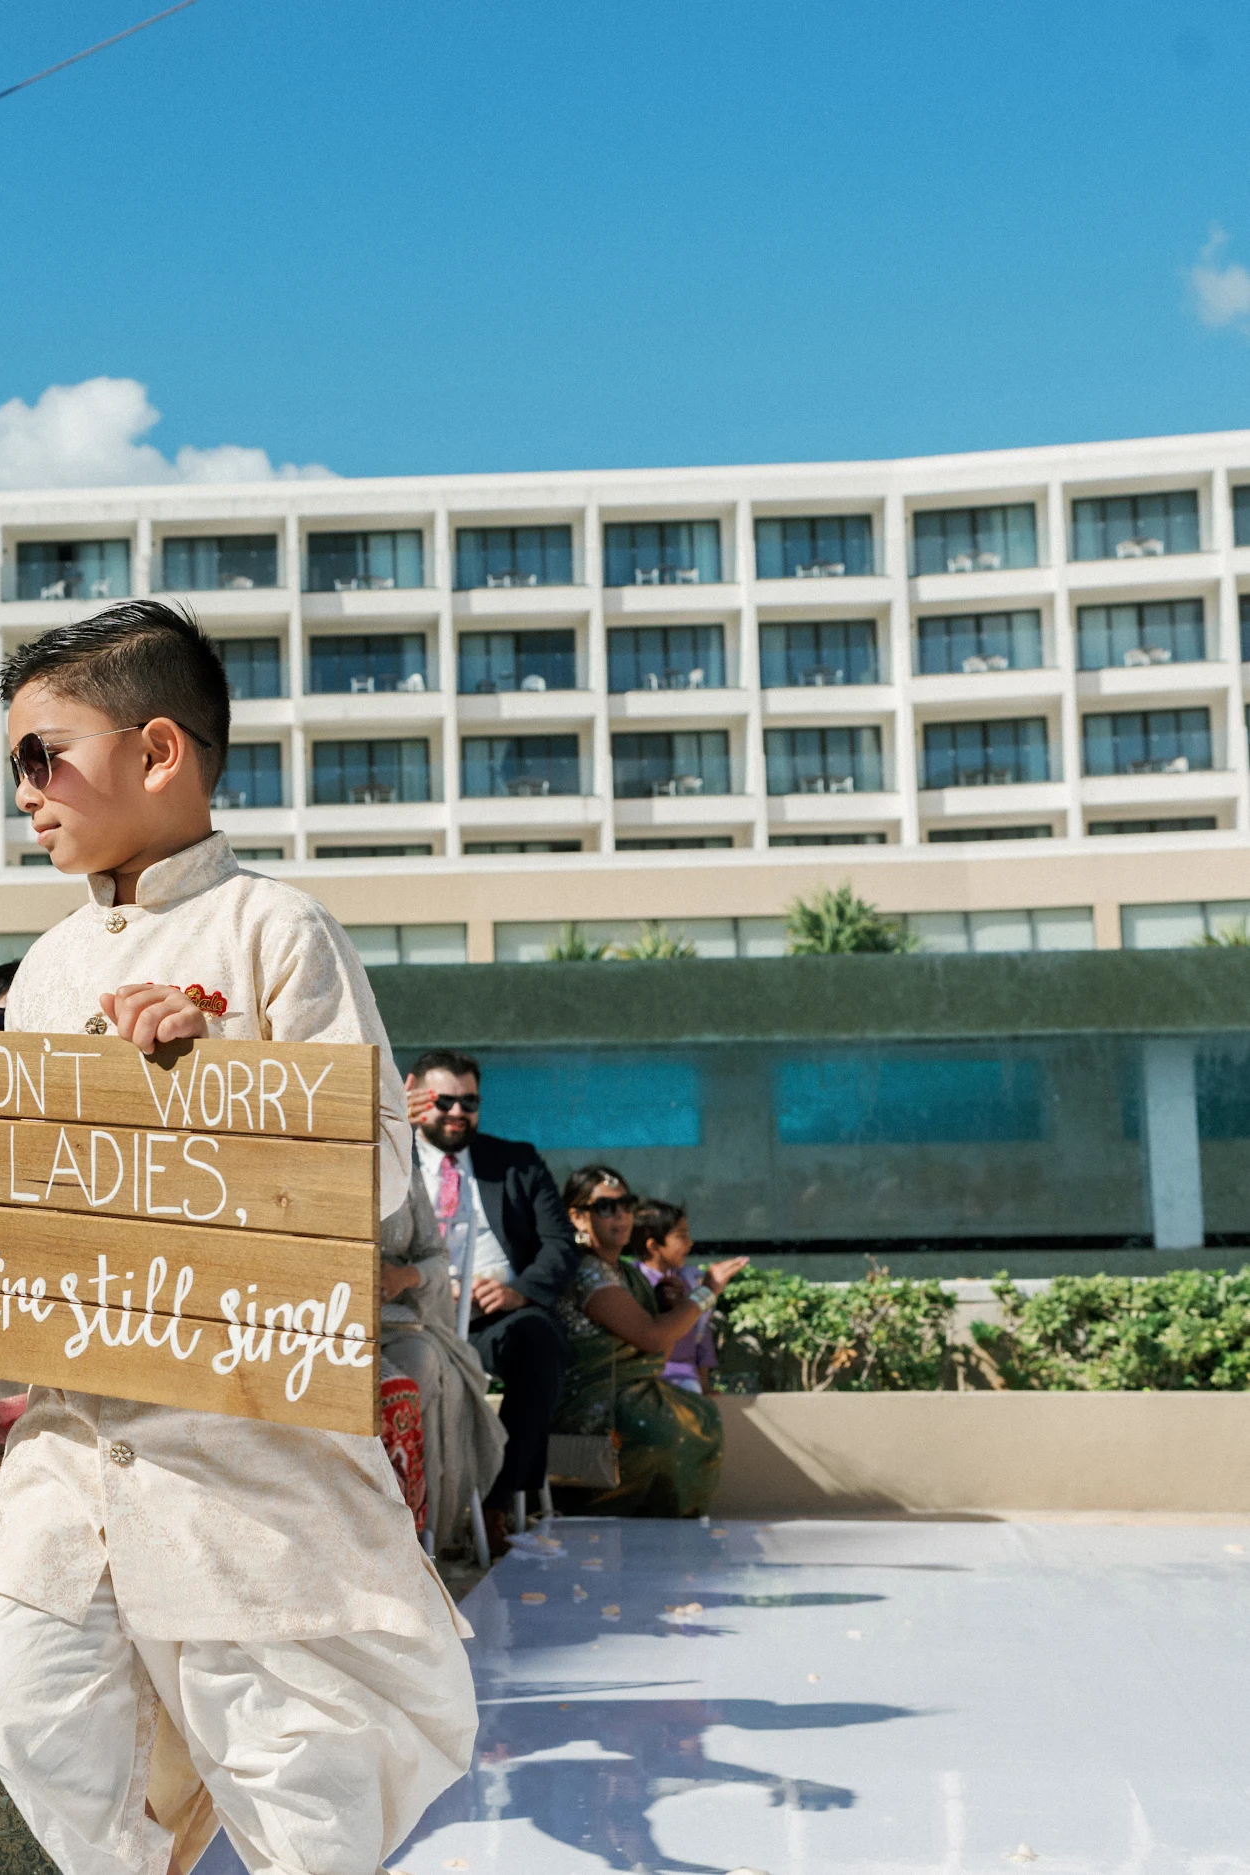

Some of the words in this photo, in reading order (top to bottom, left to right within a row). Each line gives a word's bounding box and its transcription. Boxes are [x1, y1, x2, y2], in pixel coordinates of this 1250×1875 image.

[138, 1049, 334, 1132] WORRY
[10, 1125, 248, 1226] LADIES,
[59, 1254, 203, 1359] still
[211, 1282, 374, 1402] single
